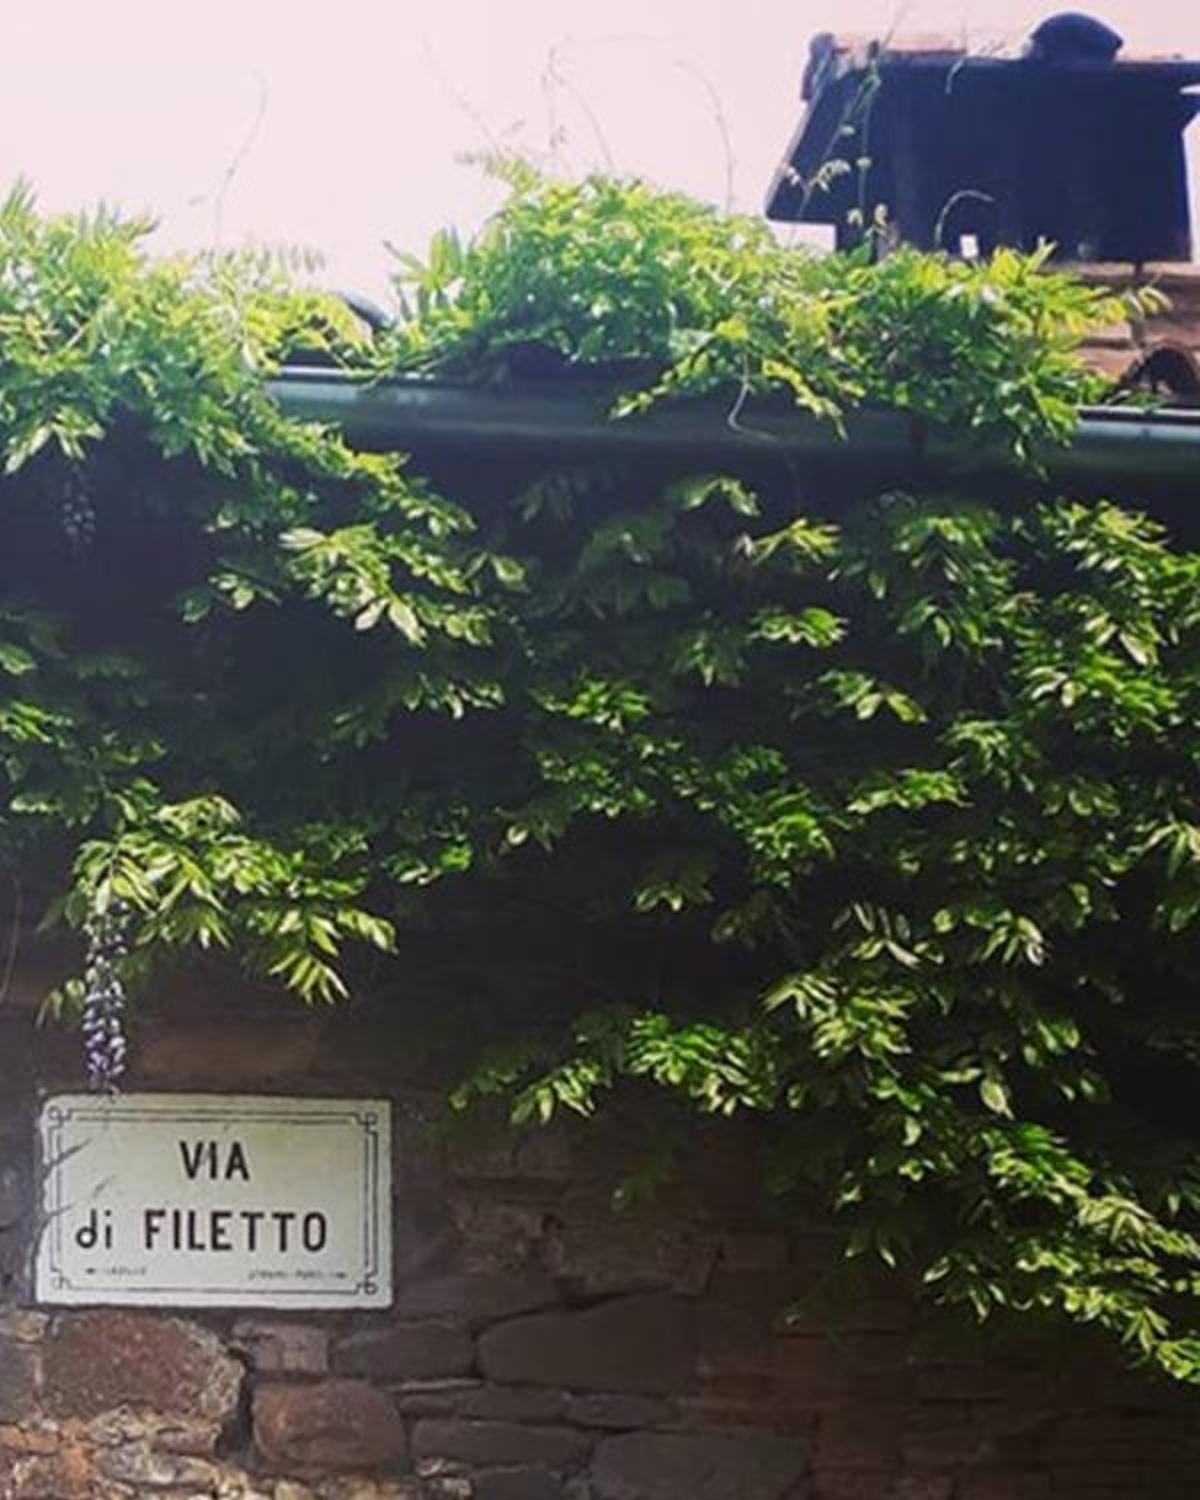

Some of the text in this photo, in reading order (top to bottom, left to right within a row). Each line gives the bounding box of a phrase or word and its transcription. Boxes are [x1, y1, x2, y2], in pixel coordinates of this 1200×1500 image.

[179, 1140, 250, 1181] VIA
[75, 1209, 327, 1251] di FILETTO
